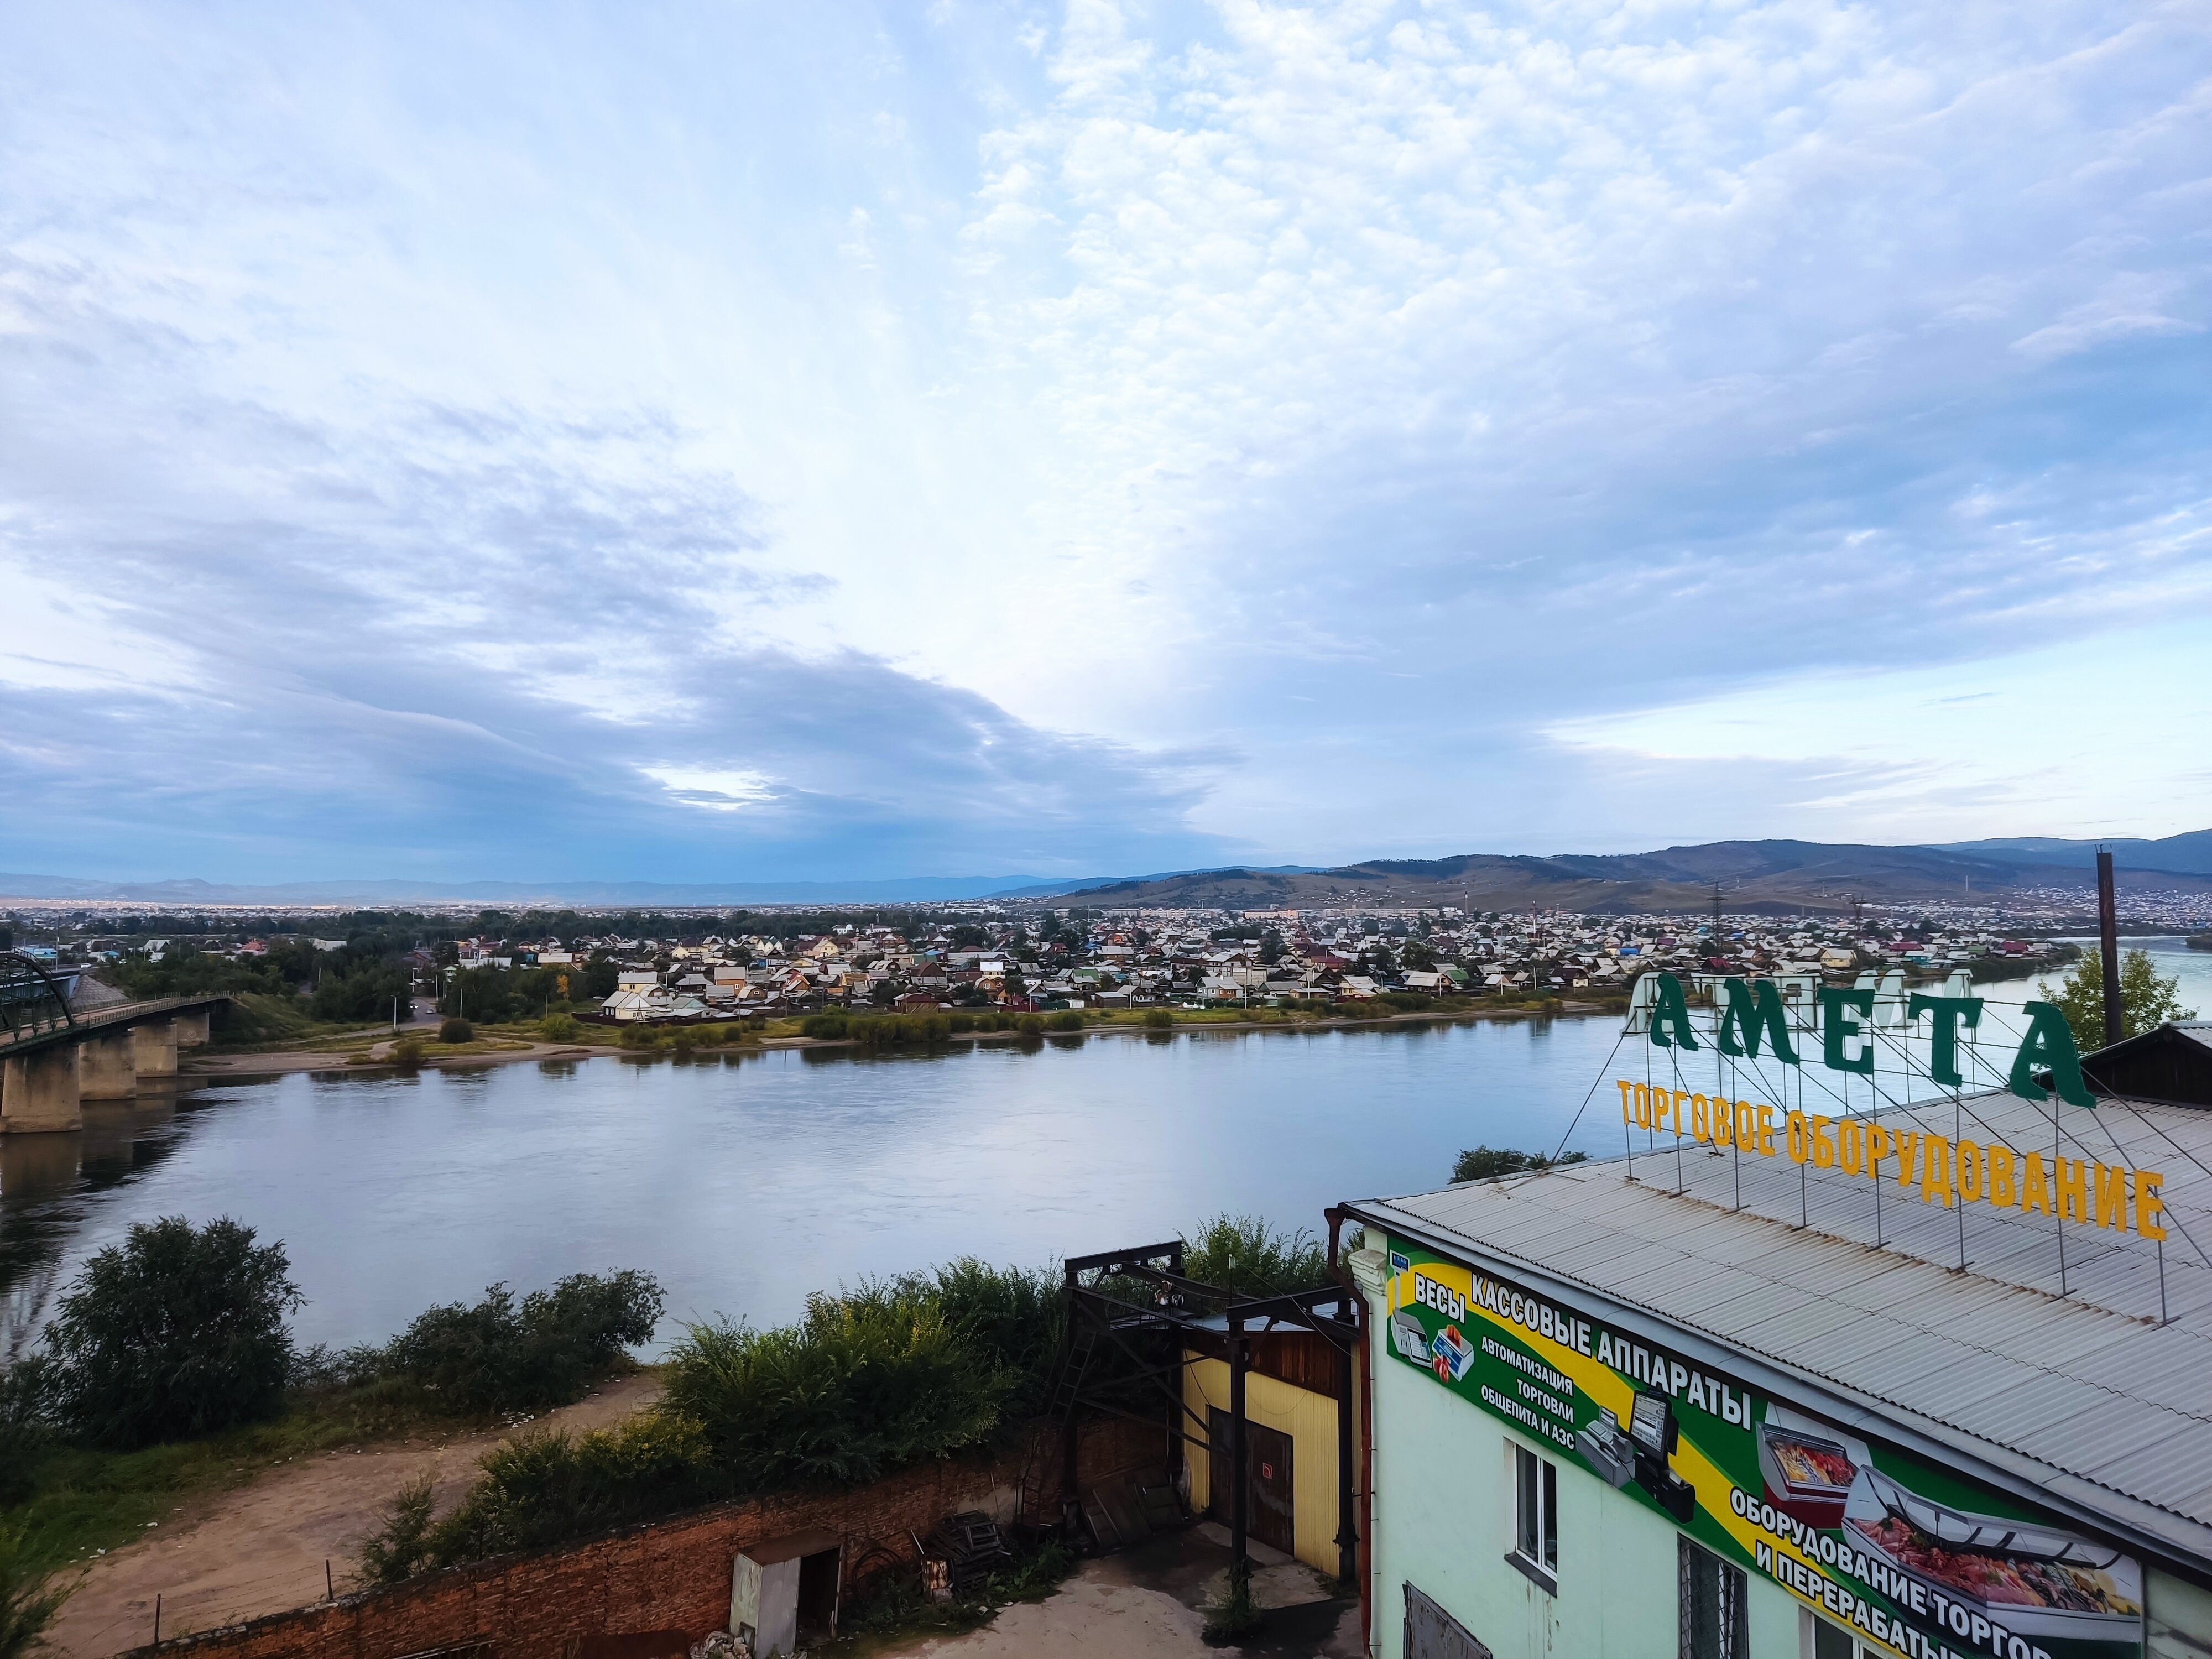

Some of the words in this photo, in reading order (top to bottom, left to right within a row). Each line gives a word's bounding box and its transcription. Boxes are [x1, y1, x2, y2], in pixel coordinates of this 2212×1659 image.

[1650, 973, 2096, 1108] АМЕТА
[1618, 1080, 1775, 1156] ТОРГОВОЕ
[1787, 1110, 2167, 1241] ОБОРУДОВАНИЕ
[1415, 1273, 1465, 1324] ВЕСЫ
[1471, 1274, 1592, 1357] КАССОВЫЕ
[1597, 1331, 1751, 1431] АППАРАТЫ
[1481, 1336, 1573, 1396] АВТОМАТИЗАЦИЯ
[1481, 1385, 1539, 1431] ОБЩЕПИТА
[1541, 1417, 1549, 1437] И
[1551, 1424, 1574, 1450] АЗС
[1517, 1379, 1574, 1423] ТОРГОВЛИ
[1731, 1489, 1927, 1616] ОБОРУДОВАНИЕ
[1757, 1542, 1772, 1573] И
[1777, 1553, 1964, 1659] ПЕРЕРАБАТЫ
